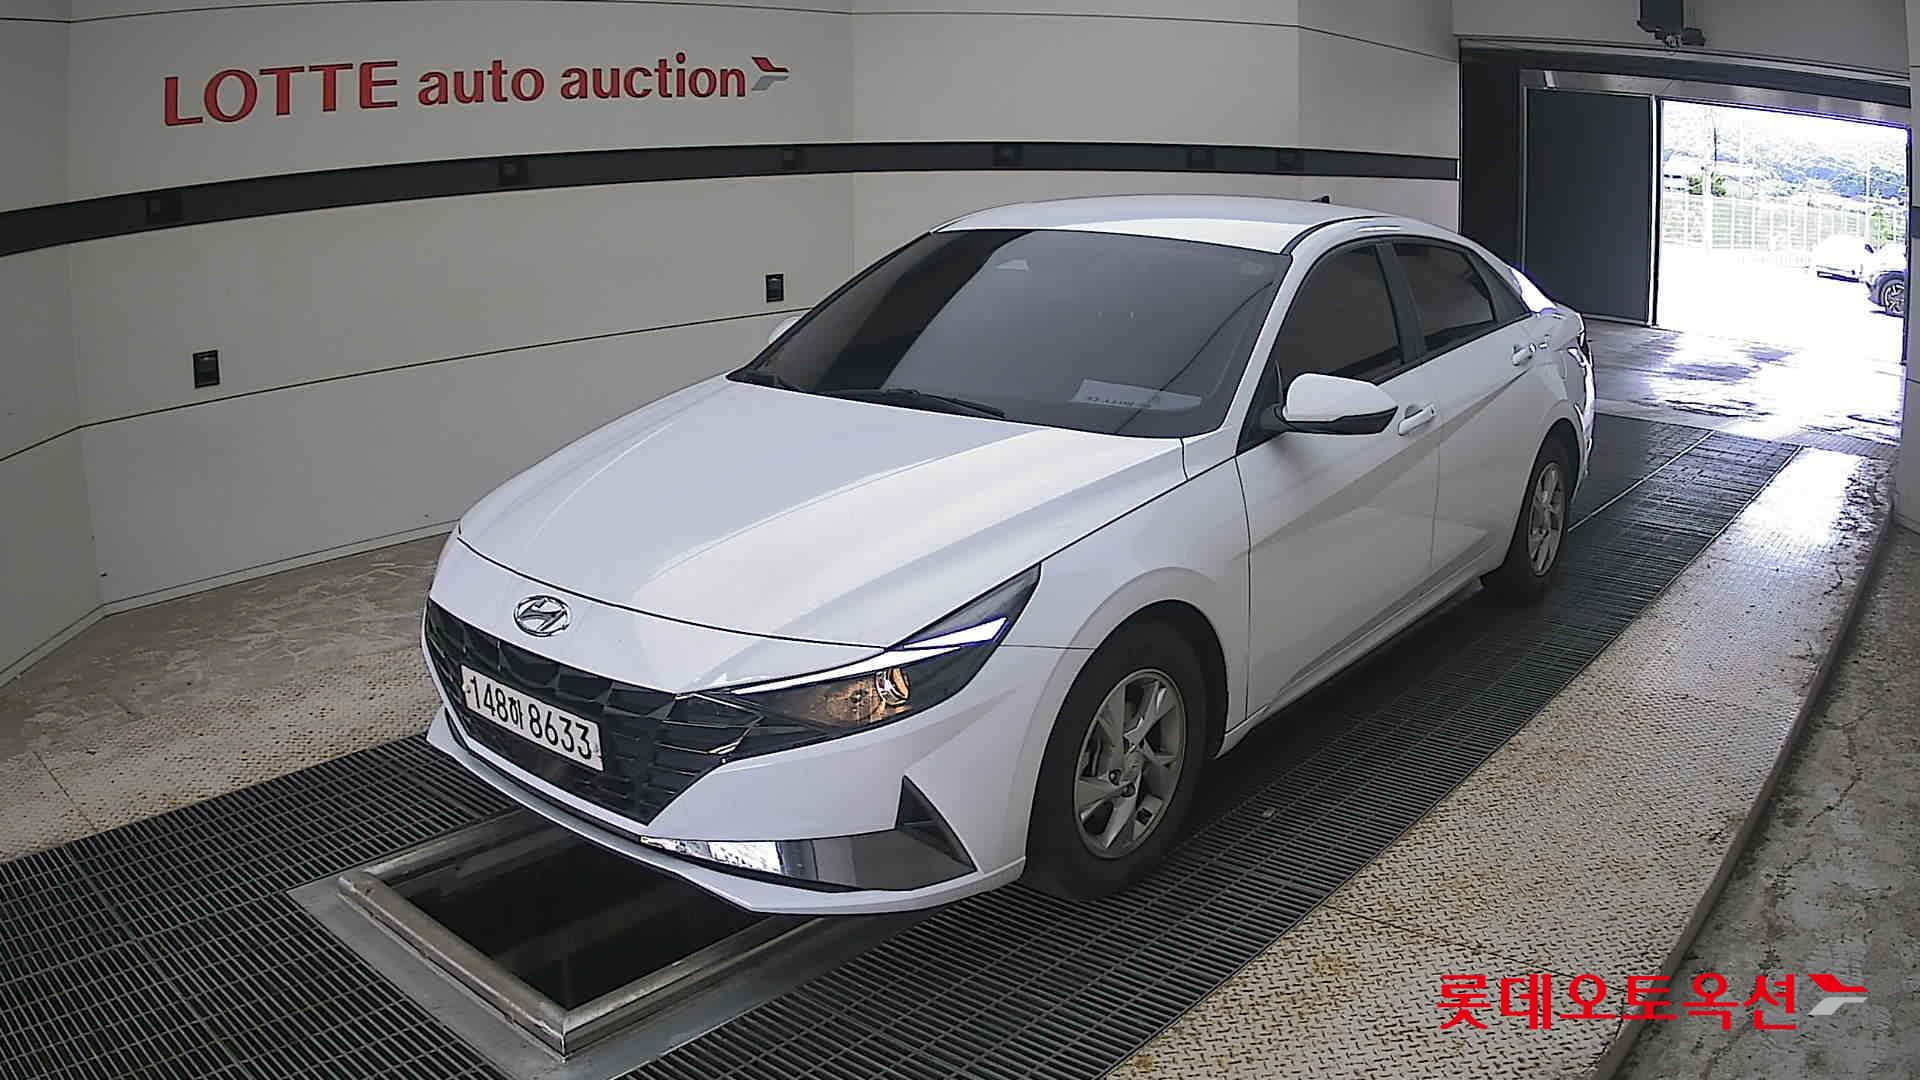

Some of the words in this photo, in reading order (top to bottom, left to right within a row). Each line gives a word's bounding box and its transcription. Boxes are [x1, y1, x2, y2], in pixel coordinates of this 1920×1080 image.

[164, 60, 399, 127] LOTTE
[417, 60, 545, 106] auto
[560, 51, 746, 100] auction
[528, 703, 592, 760] 8633
